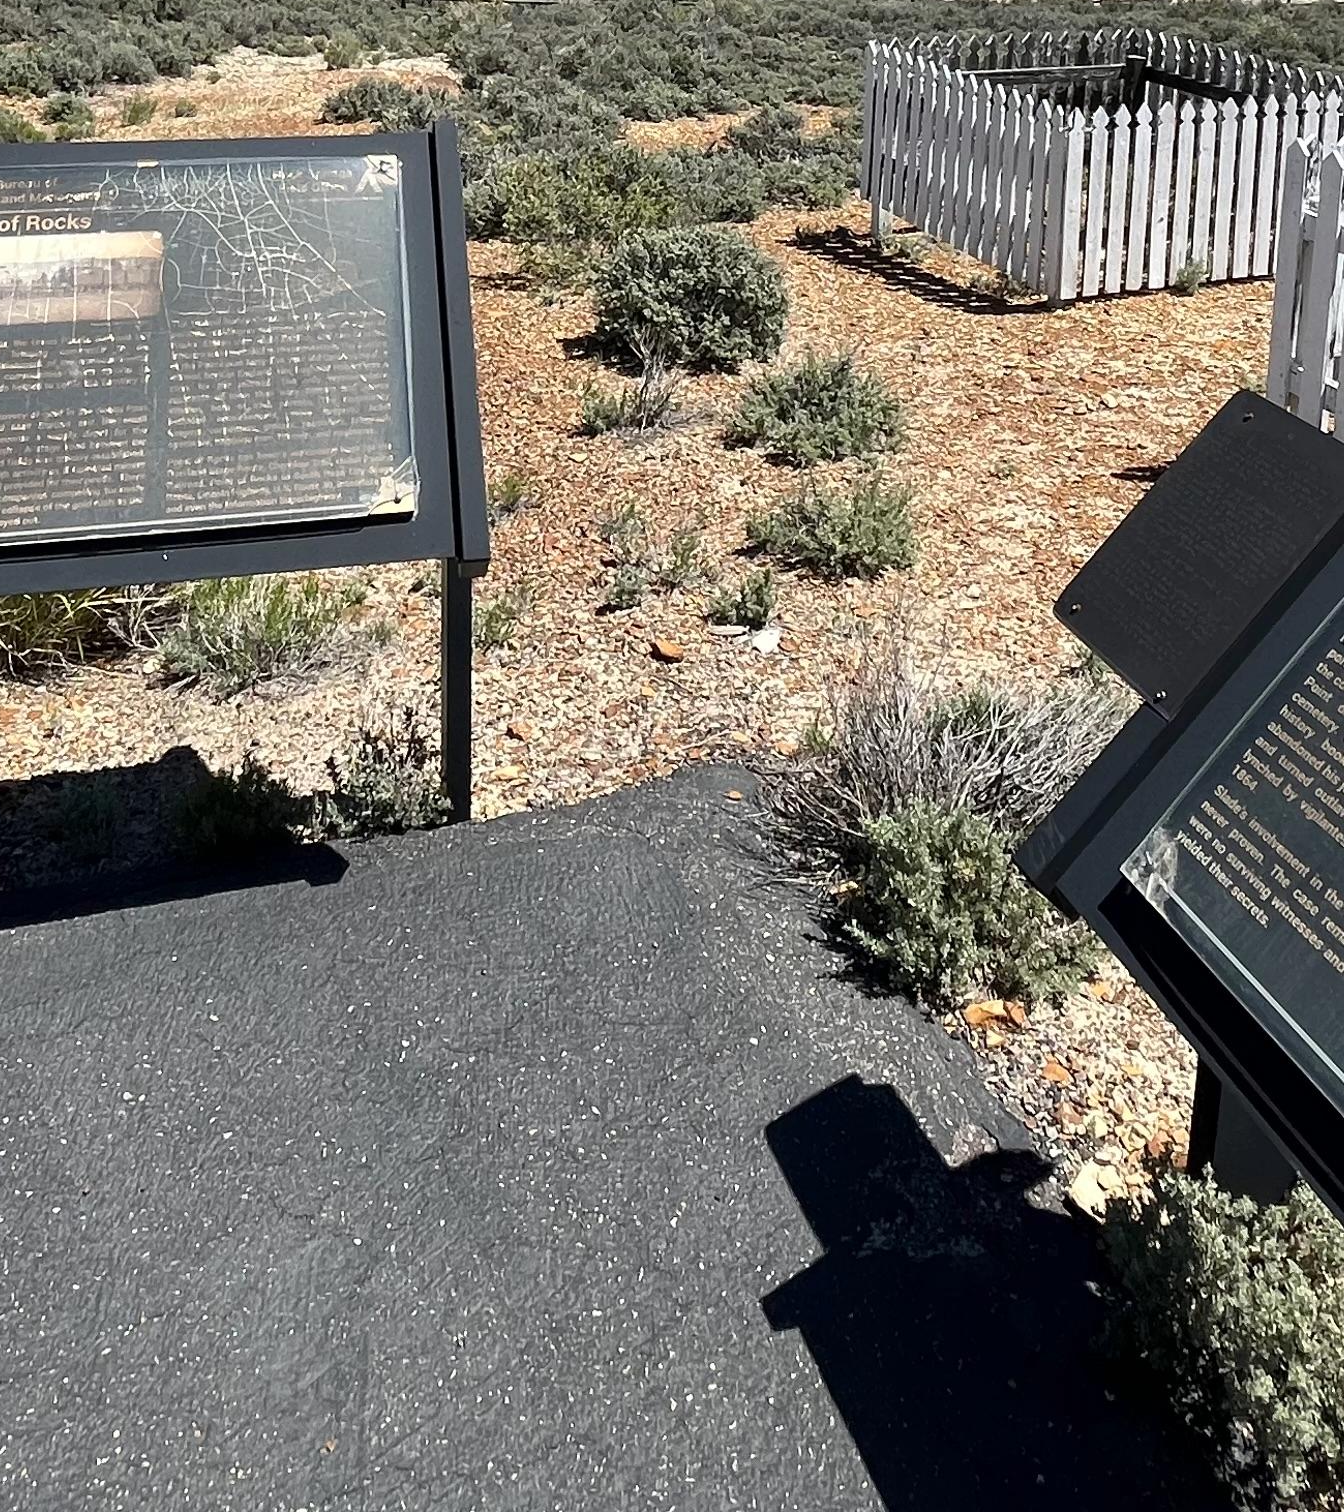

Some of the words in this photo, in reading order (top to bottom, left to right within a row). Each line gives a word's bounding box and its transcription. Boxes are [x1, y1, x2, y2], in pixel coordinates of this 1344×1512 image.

[25, 213, 92, 231] Rocks
[1242, 747, 1284, 788] lynched
[1281, 782, 1298, 802] by
[1254, 735, 1278, 756] and
[1277, 754, 1315, 787] turned
[1172, 829, 1213, 867] yielded
[1207, 860, 1233, 888] their
[1229, 885, 1269, 928] secrets.
[1188, 814, 1212, 841] were
[1210, 837, 1226, 854] no
[1225, 852, 1272, 901] surviving
[1270, 895, 1324, 950] witnesses
[1200, 800, 1229, 828] never
[1227, 827, 1264, 866] proven.
[1269, 862, 1290, 889] The
[1291, 888, 1319, 916] case
[1213, 784, 1248, 820] Slade's
[1247, 815, 1310, 878] involvement
[1308, 872, 1323, 891] in
[1323, 887, 1344, 911] the
